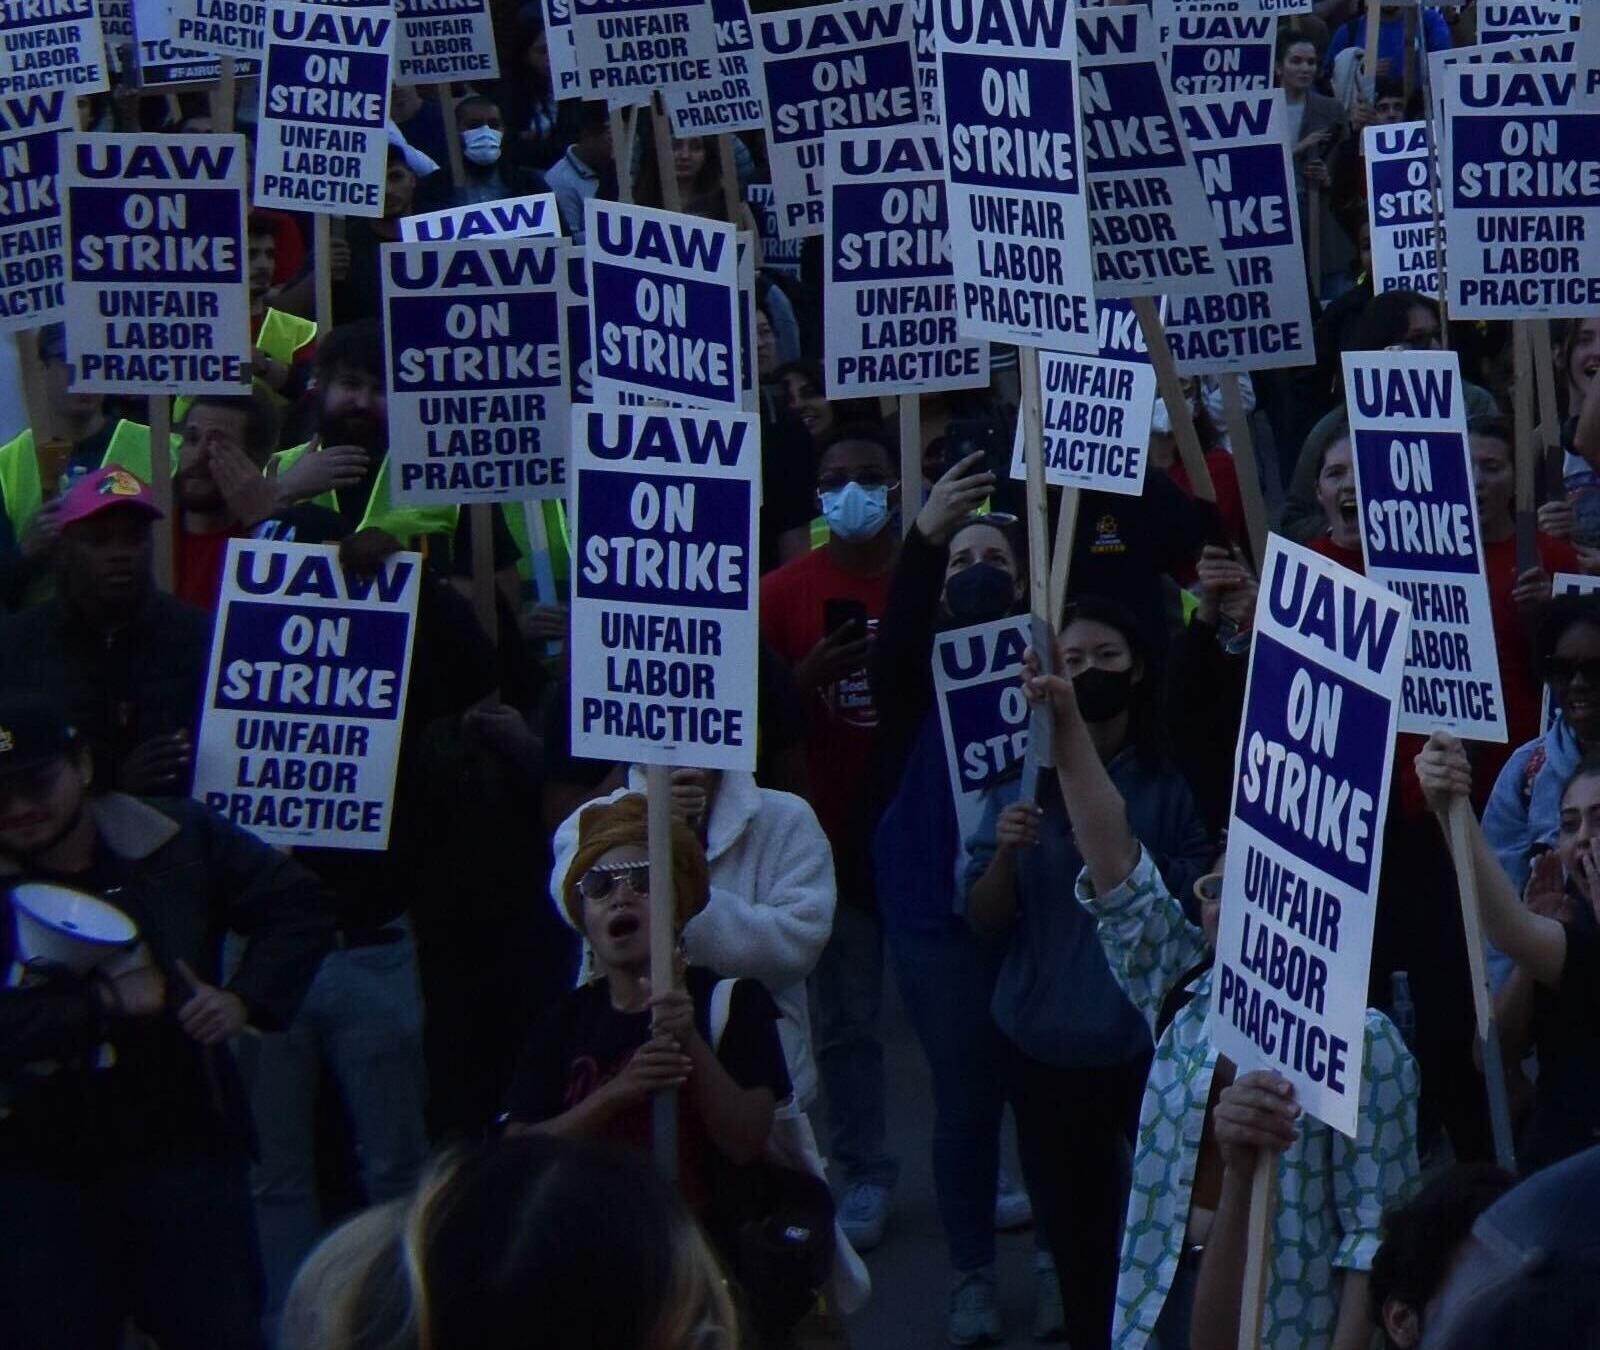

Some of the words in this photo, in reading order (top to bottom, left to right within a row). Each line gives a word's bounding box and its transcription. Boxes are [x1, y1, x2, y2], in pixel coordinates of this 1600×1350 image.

[272, 8, 391, 48] UAW
[170, 62, 250, 79] #FAIRUCOW
[304, 53, 350, 85] ON
[980, 66, 1031, 118] ON
[269, 84, 382, 121] STRIKE
[279, 124, 366, 153] UNFAIR
[952, 123, 1074, 182] STRIKE
[282, 150, 360, 178] LABOR
[263, 174, 378, 205] PRACTICE
[969, 193, 1064, 239] UNFAIR
[977, 238, 1063, 285] LABOR
[962, 282, 1088, 333] PRACTICE
[588, 411, 749, 466] UAW
[629, 481, 695, 533] ON
[583, 535, 743, 594] STRIKE
[600, 610, 719, 655] UNFAIR
[1269, 550, 1400, 675] UAW
[606, 655, 713, 699] LABOR
[582, 697, 742, 745] PRACTICE
[1286, 667, 1343, 758] ON
[1241, 732, 1371, 865] STRIKE
[1242, 843, 1339, 952] UNFAIR
[1237, 911, 1325, 1015] LABOR
[1218, 966, 1349, 1094] PRACTICE
